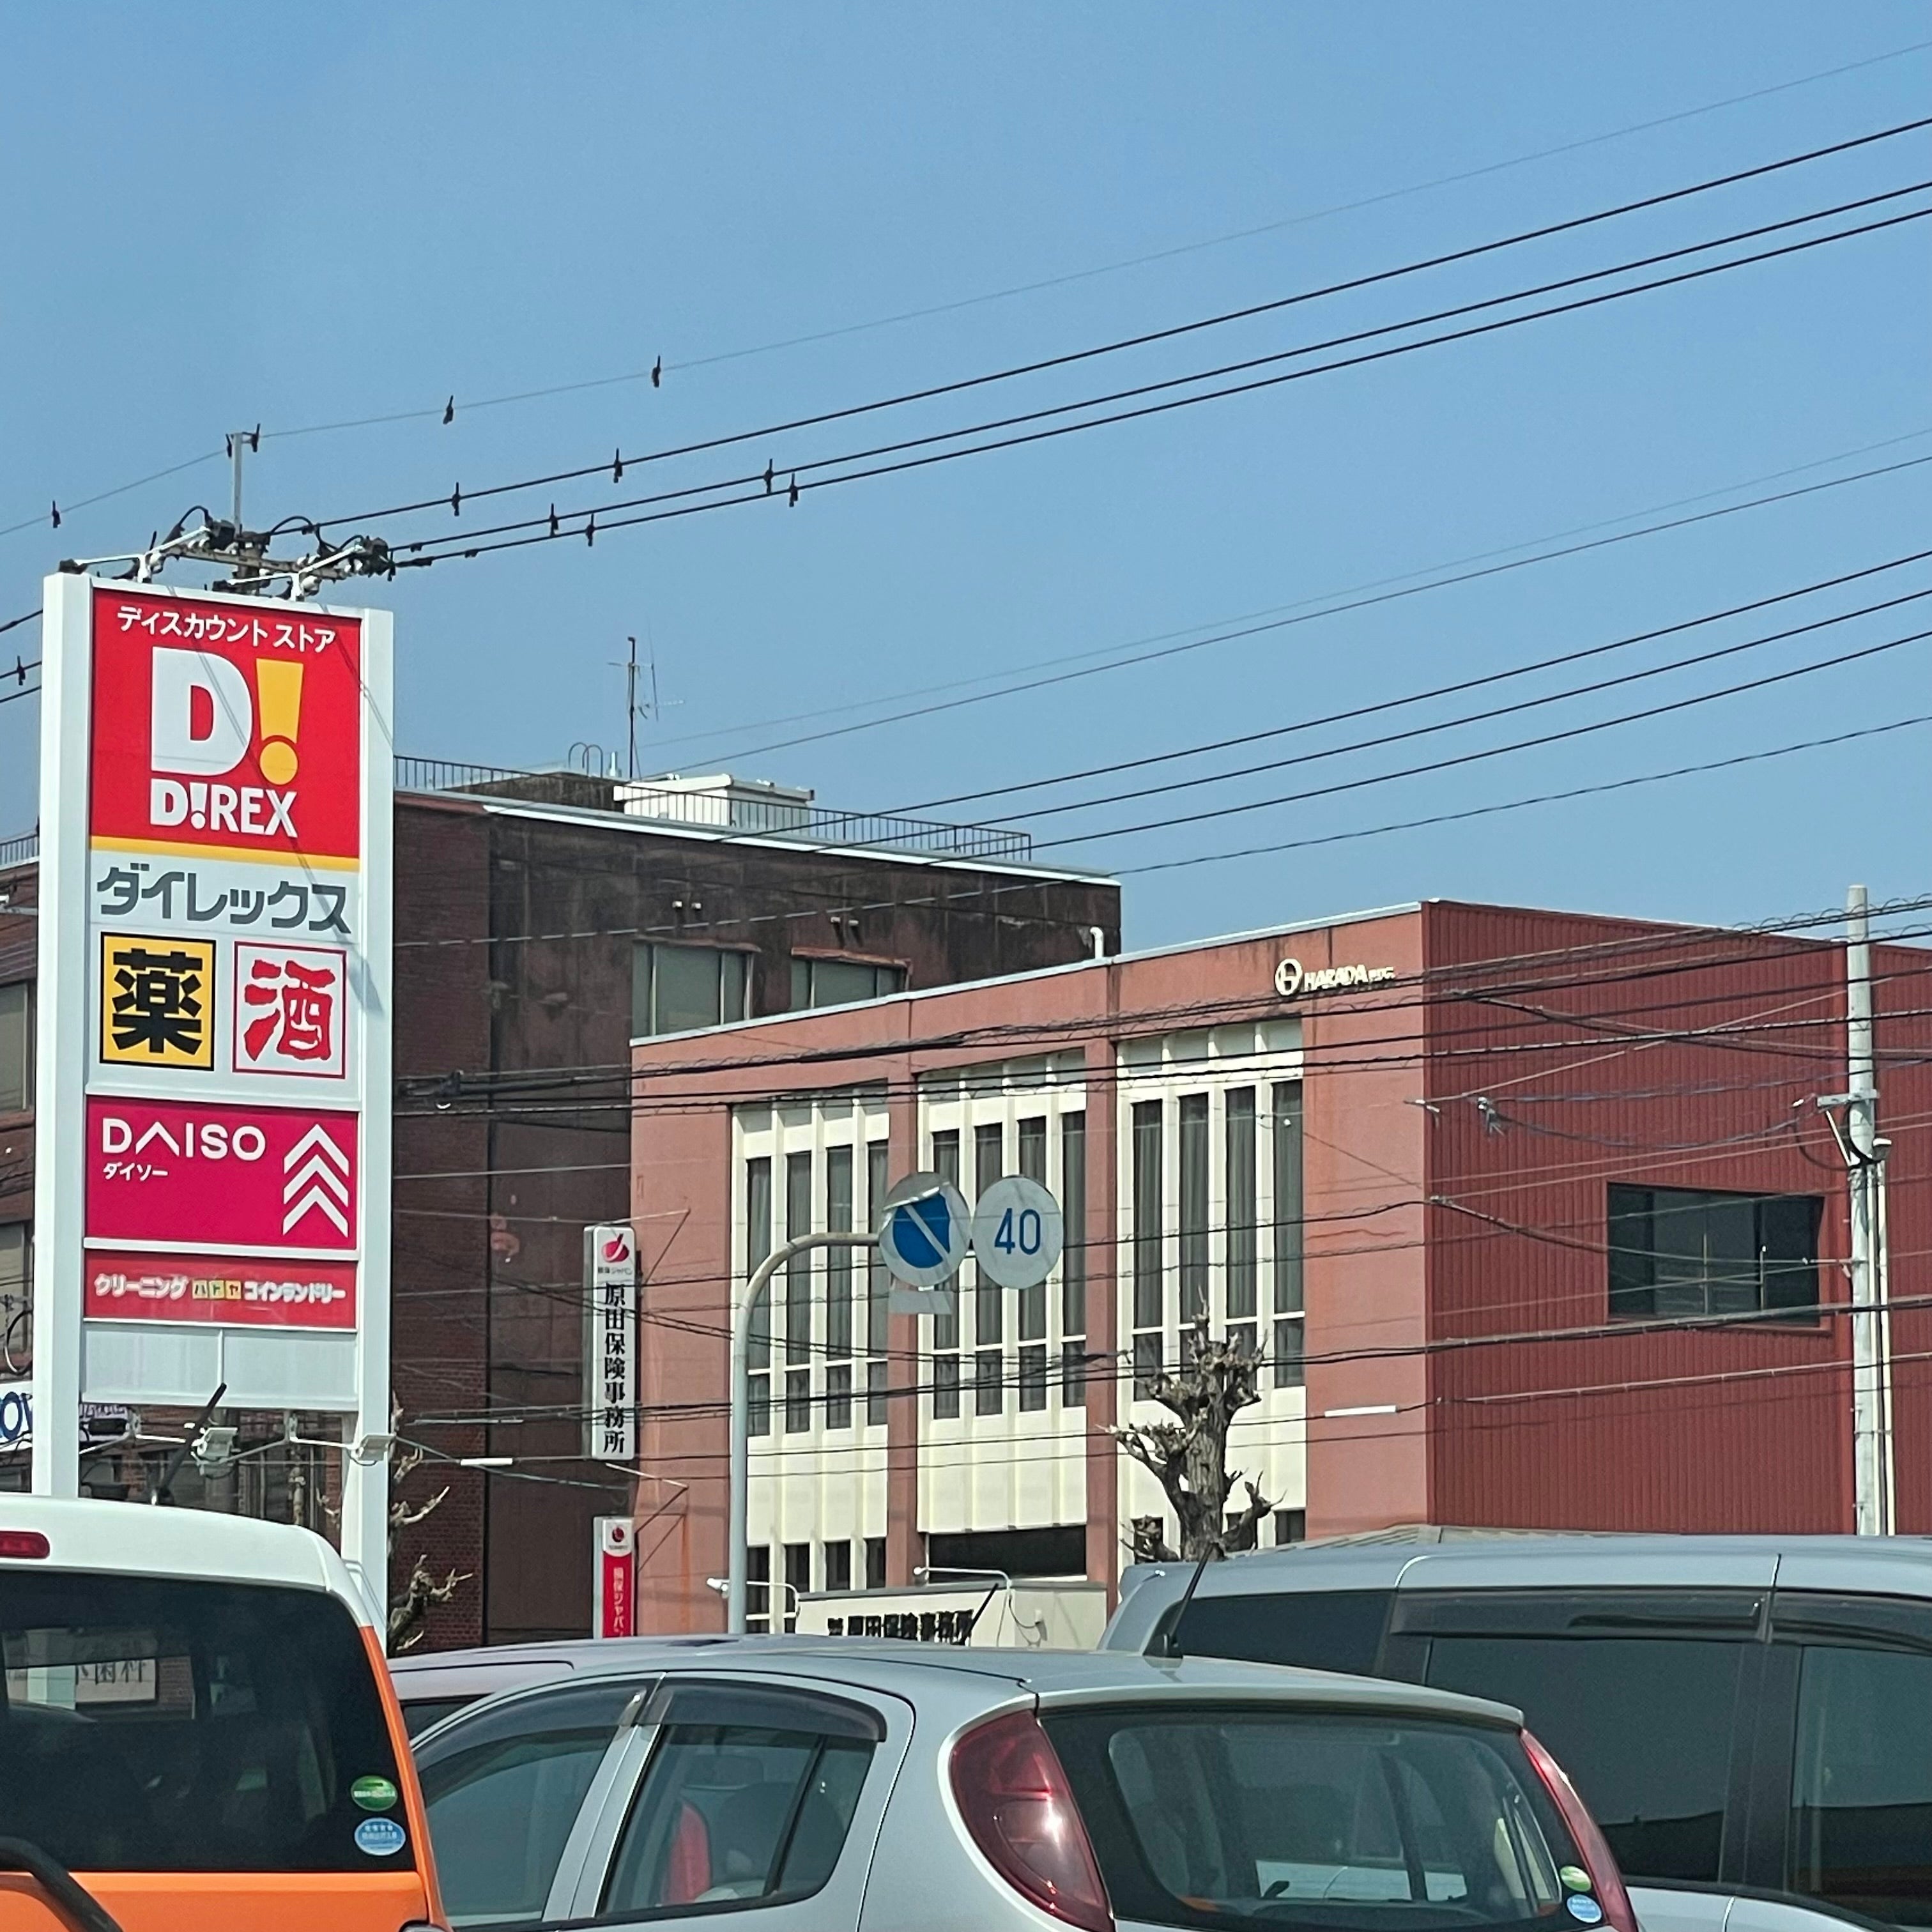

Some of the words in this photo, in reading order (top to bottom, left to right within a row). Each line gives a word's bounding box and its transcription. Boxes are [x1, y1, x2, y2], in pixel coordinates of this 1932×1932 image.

[96, 862, 352, 935] ダイレックス
[112, 947, 203, 1054] 薬
[1304, 963, 1369, 992] HARADA
[243, 958, 336, 1061] 酒
[102, 1117, 266, 1161] DAISO
[102, 1162, 169, 1183] ダイソー
[994, 1208, 1041, 1255] 40
[94, 1273, 192, 1300] クリーニング
[244, 1280, 346, 1304] コインランドリー
[603, 1282, 626, 1454] 原田保険事務所
